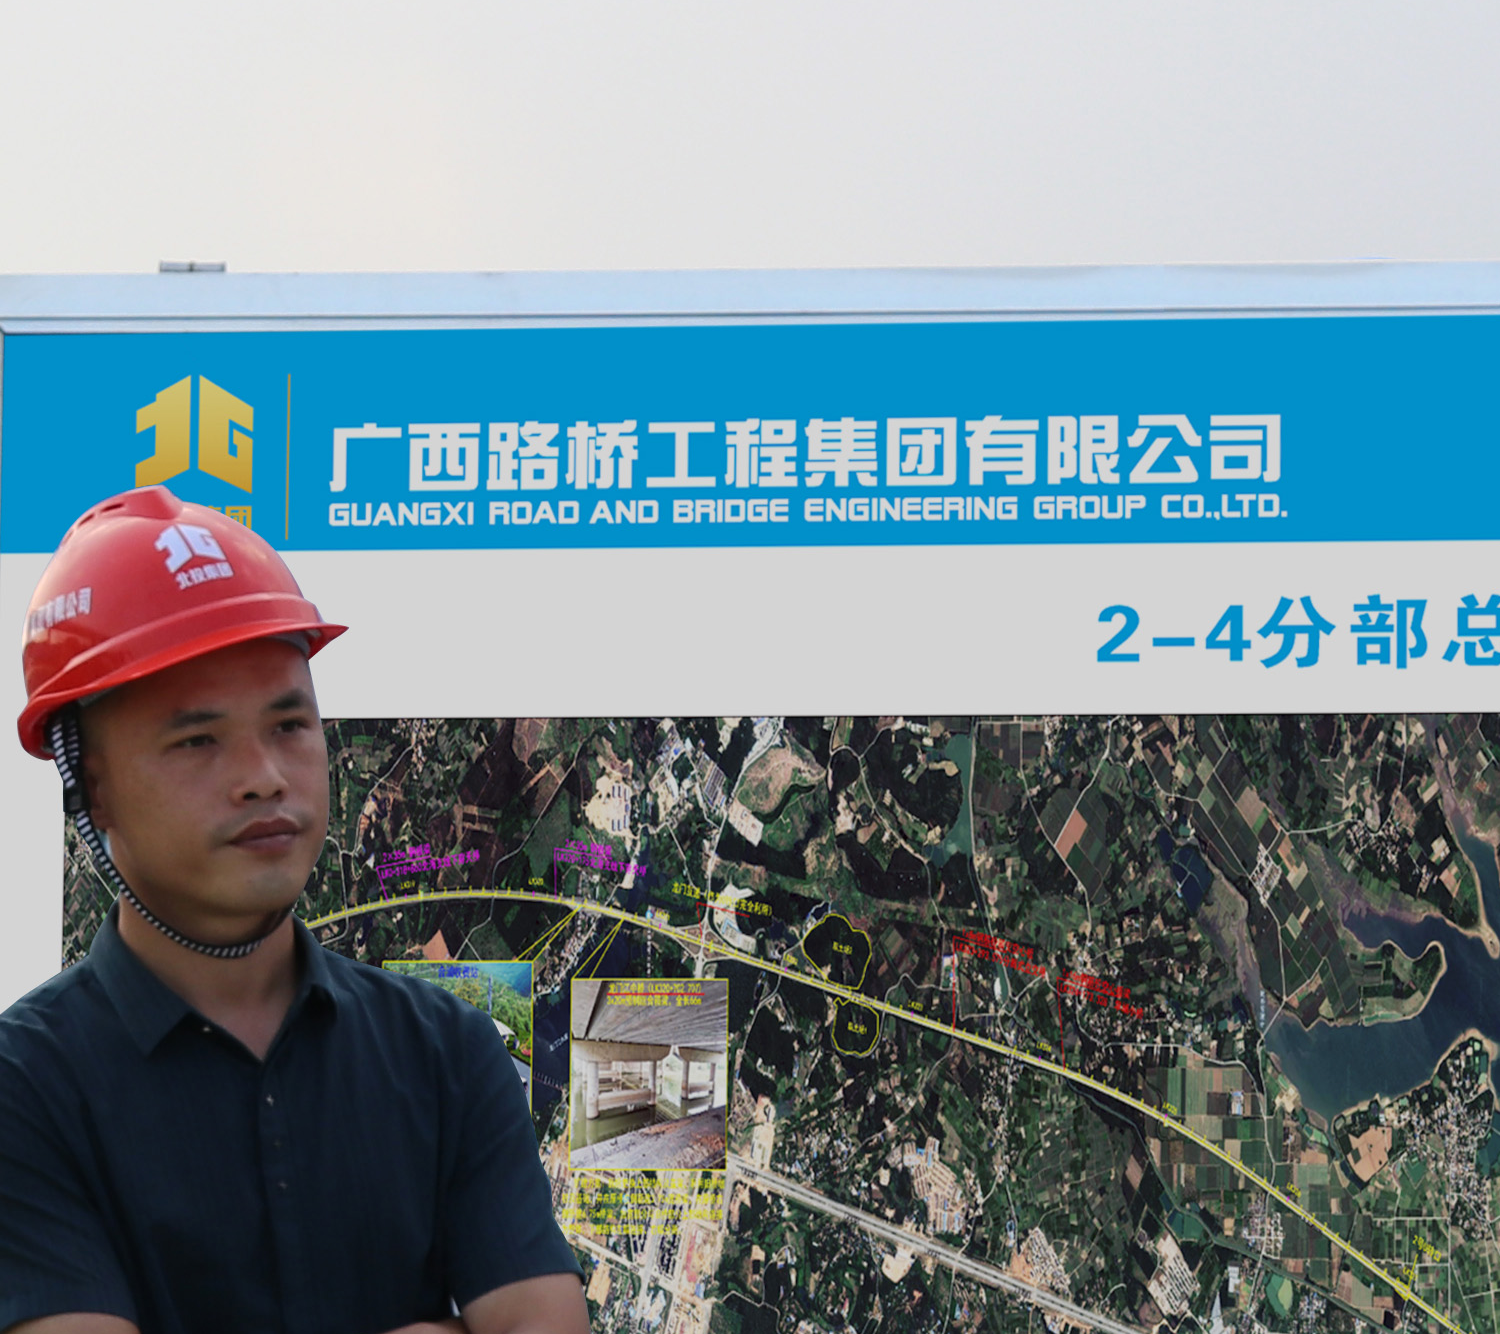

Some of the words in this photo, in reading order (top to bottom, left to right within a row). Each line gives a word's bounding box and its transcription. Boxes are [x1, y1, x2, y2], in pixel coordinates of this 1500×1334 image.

[328, 413, 1283, 493] 广西路桥工程集团有限公司
[328, 501, 475, 527] GUANGXI
[488, 500, 580, 525] ROAD
[589, 499, 660, 525] AND
[672, 498, 790, 524] BRIDGE
[803, 496, 1019, 522] ENGINEERING
[1033, 494, 1147, 520] GROUP
[1161, 493, 1289, 521] CO.,LTD.
[173, 561, 235, 591] 北投集团
